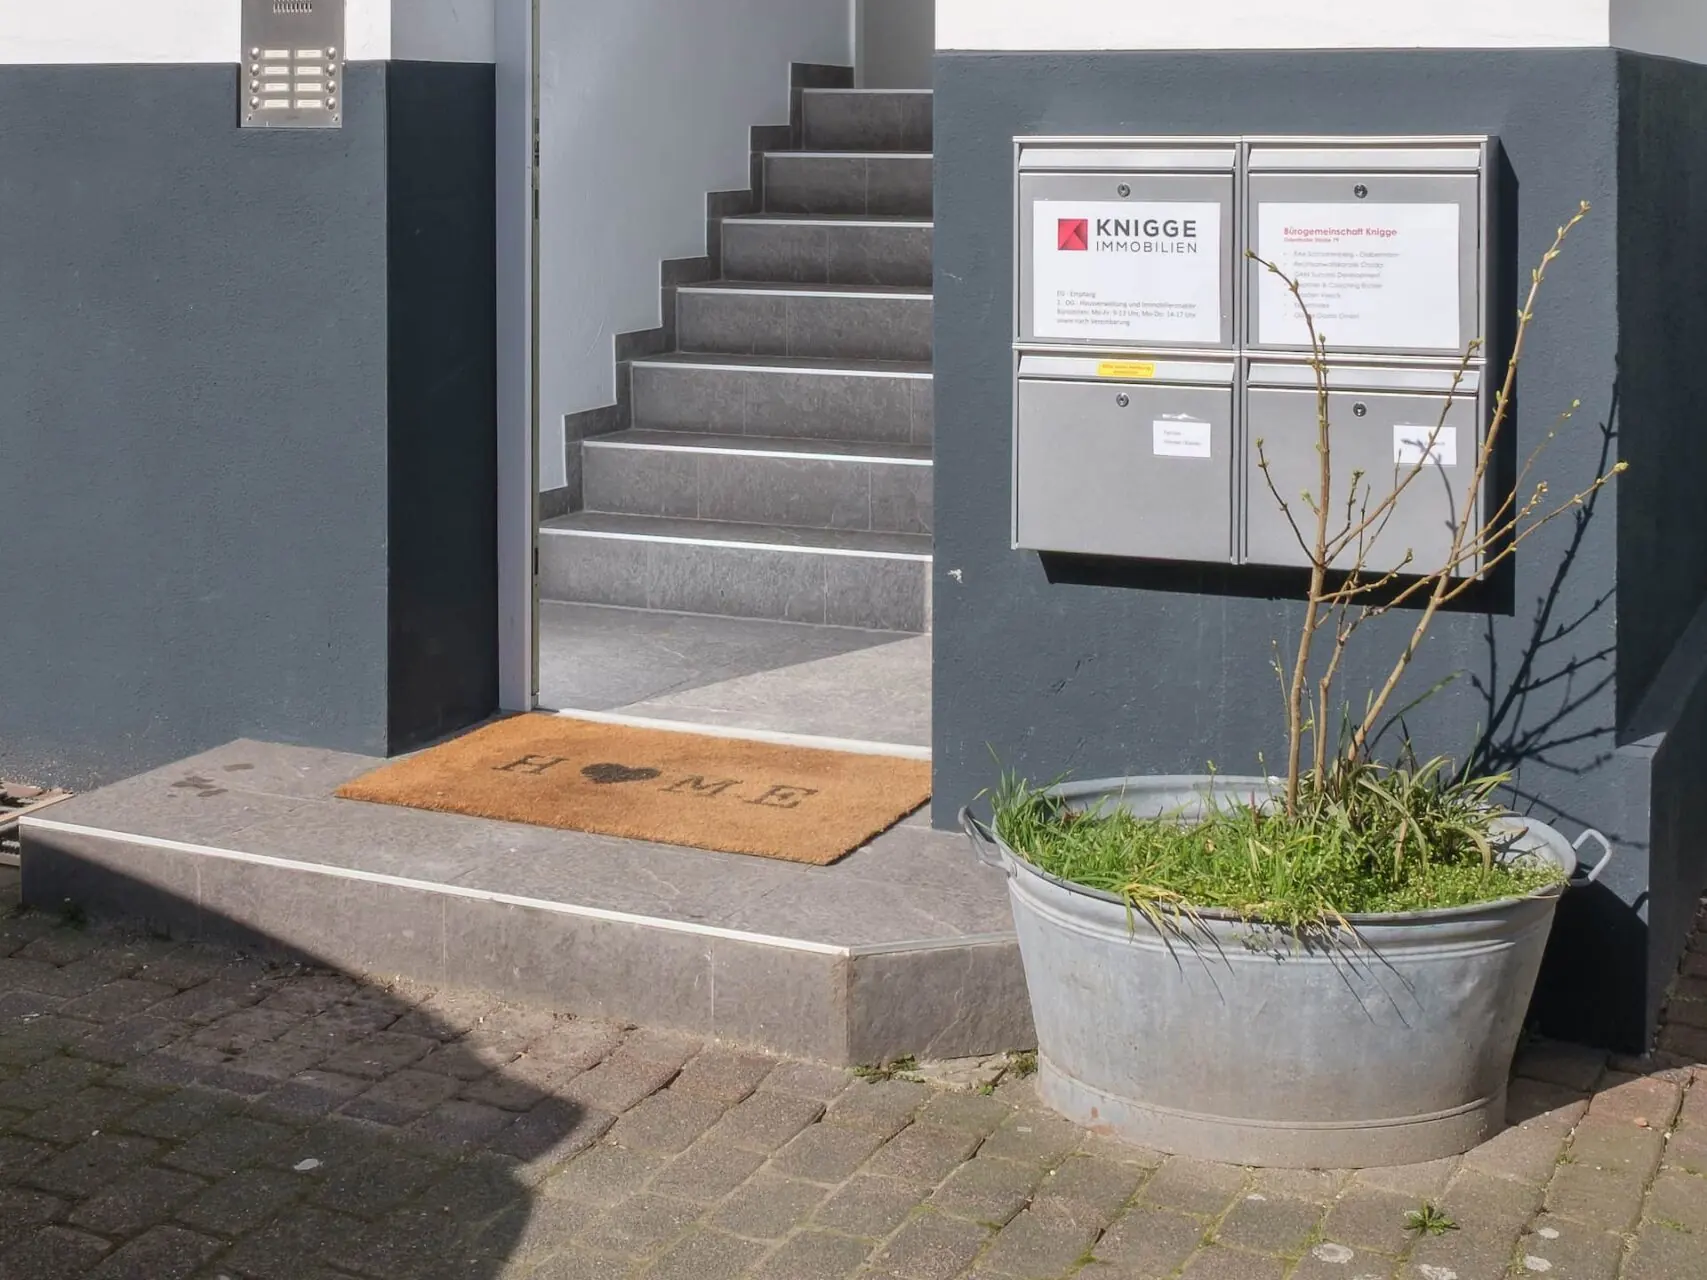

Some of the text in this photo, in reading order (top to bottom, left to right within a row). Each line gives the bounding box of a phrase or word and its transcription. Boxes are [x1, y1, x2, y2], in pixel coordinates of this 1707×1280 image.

[1096, 218, 1197, 238] KNIGGE
[1283, 226, 1398, 238] Bürogemeinschaft Knigge
[1096, 241, 1197, 253] IMMOBILIEN
